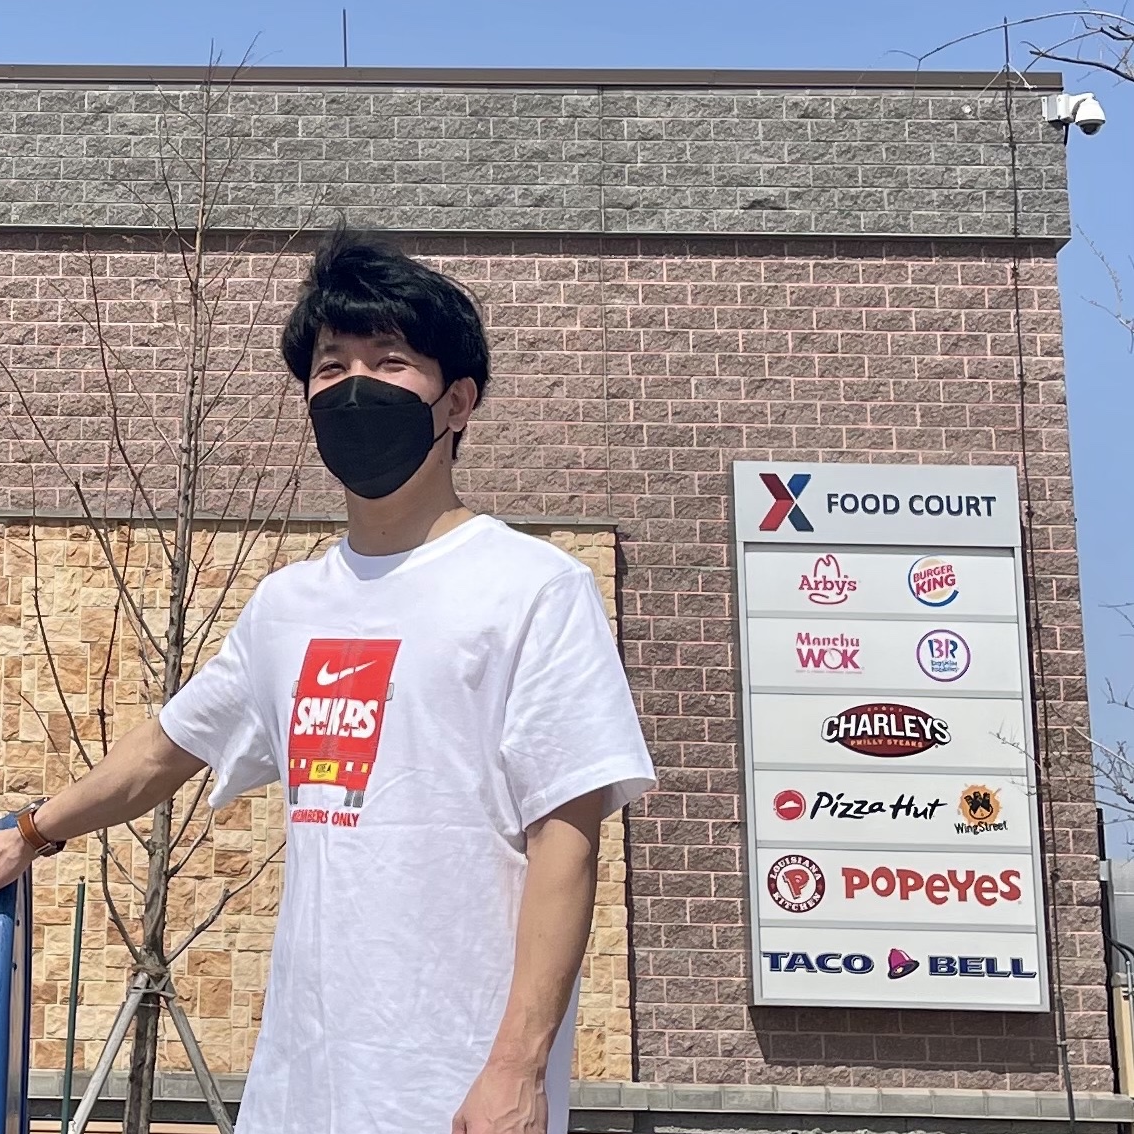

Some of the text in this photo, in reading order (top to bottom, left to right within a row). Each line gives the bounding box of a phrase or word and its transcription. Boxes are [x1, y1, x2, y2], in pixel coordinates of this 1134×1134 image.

[827, 493, 997, 517] FOOD COURT
[913, 564, 954, 582] BURGER
[798, 574, 857, 596] Arby's
[916, 574, 956, 597] KING
[796, 632, 860, 647] Manchu
[796, 648, 861, 670] WOK
[822, 713, 951, 743] CHARLEYS
[810, 791, 948, 820] Pizza Hut
[331, 811, 361, 828] ONLY
[769, 856, 822, 880] LOUISIANA
[772, 891, 821, 912] KITCHEN
[763, 951, 1037, 979] TACO BELL
